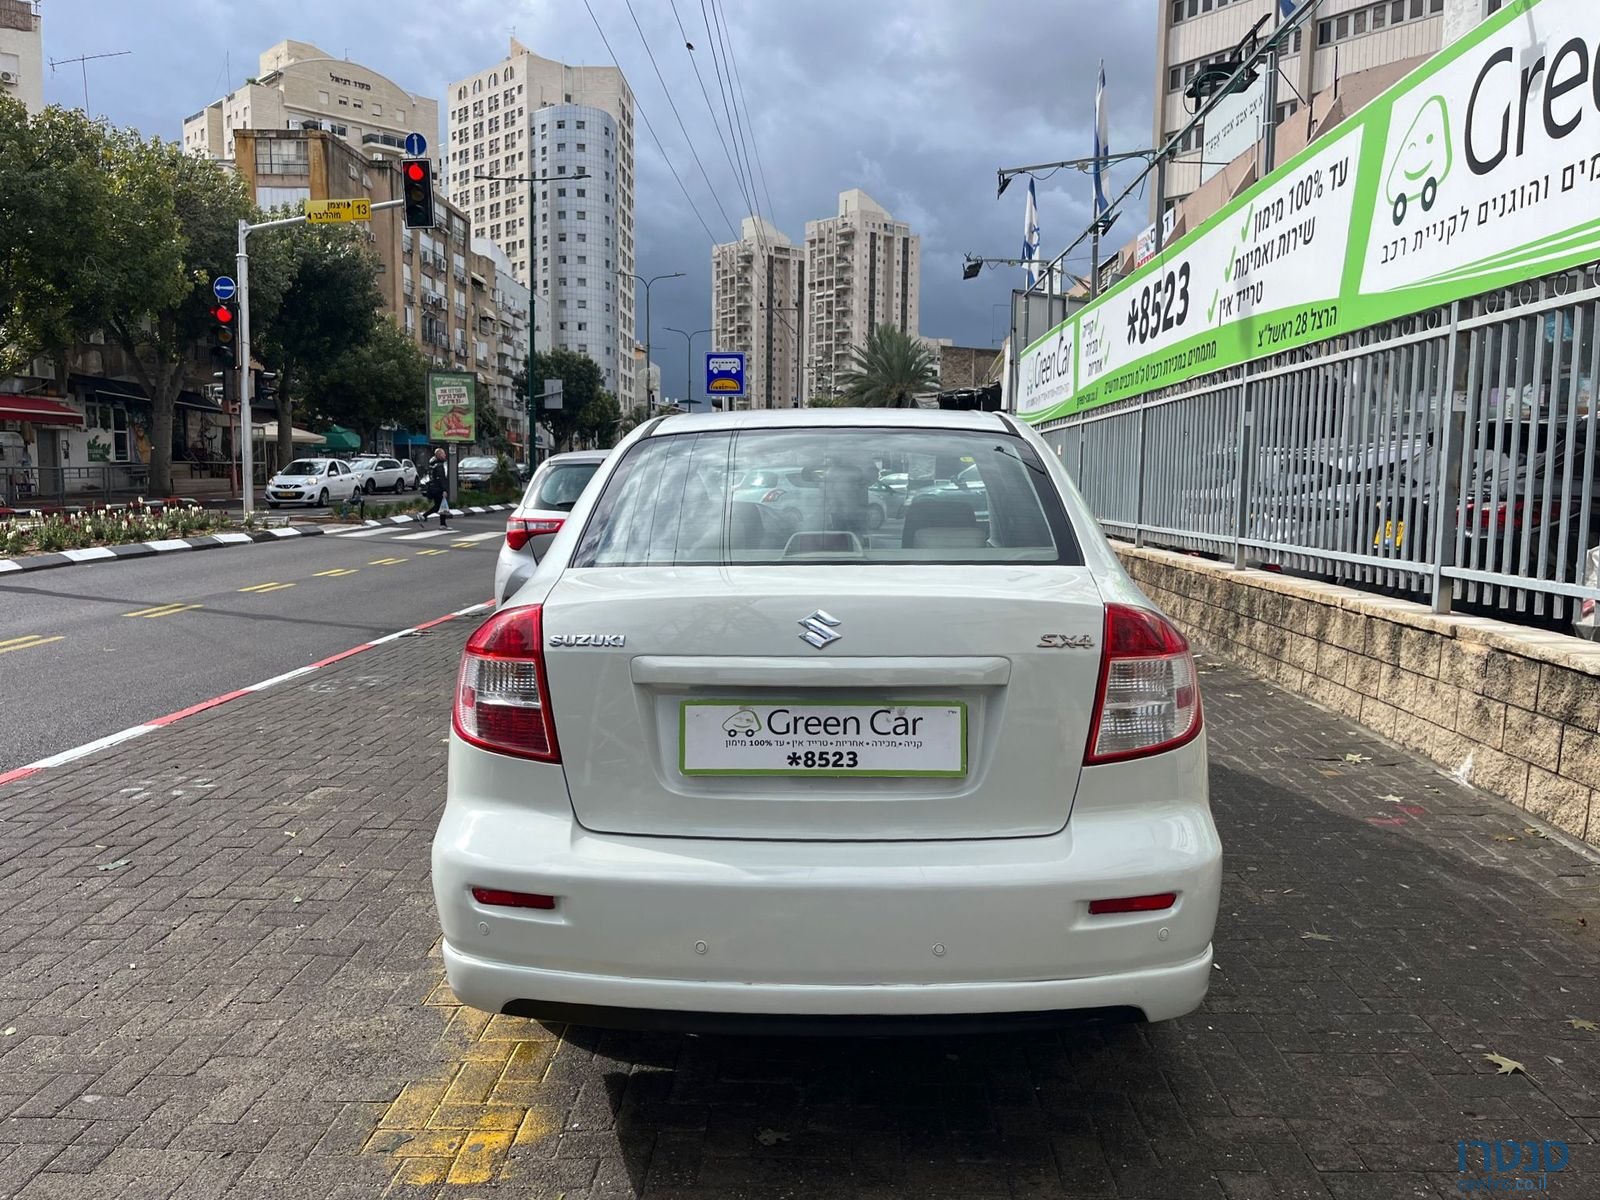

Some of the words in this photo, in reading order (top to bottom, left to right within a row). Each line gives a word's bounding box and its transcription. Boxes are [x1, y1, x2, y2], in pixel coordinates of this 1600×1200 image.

[1464, 37, 1600, 175] Gre
[1329, 156, 1349, 191] עד
[1289, 169, 1323, 215] 100%
[1477, 174, 1549, 226] והוגנים
[327, 201, 346, 211] ויצמן
[356, 204, 367, 215] 13
[1254, 197, 1284, 242] מימון
[1276, 216, 1316, 260] שירות
[1412, 205, 1469, 252] לקניית
[1233, 240, 1275, 281] ואמינות
[1381, 237, 1407, 264] רכב
[1218, 293, 1233, 327] אין
[1236, 280, 1264, 313] טרייד
[1295, 311, 1308, 337] 28
[1310, 305, 1337, 331] הרצל
[1034, 351, 1056, 389] Green
[1056, 335, 1072, 378] Car
[549, 633, 625, 648] SUZUKI
[1036, 633, 1095, 649] SX4
[767, 709, 860, 736] Green
[870, 709, 923, 736] Car
[725, 740, 747, 749] מימון
[792, 740, 804, 749] אין
[835, 740, 864, 748] אחריות
[871, 740, 897, 748] מכירה
[904, 740, 923, 749] קניה
